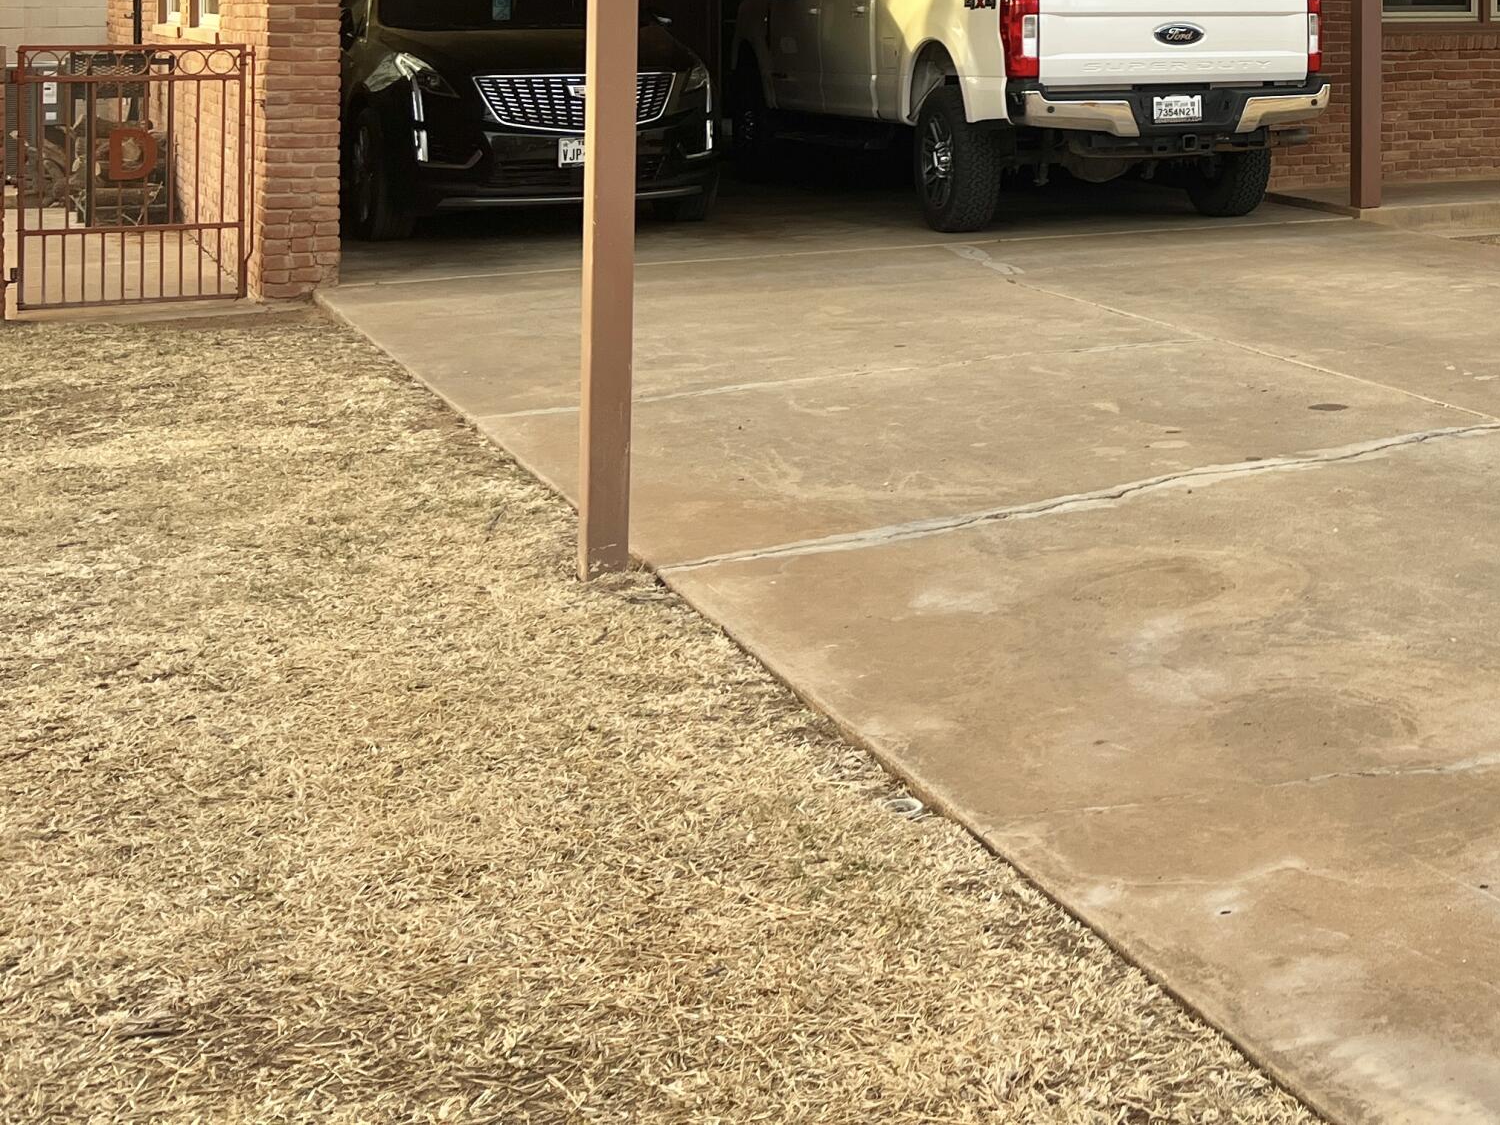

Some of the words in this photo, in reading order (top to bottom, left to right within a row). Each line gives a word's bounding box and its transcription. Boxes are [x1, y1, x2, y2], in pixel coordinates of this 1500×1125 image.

[1166, 27, 1194, 41] Ford
[1083, 60, 1189, 73] SUPER
[1195, 59, 1272, 71] DUTY
[1158, 107, 1196, 117] 7354N21
[109, 128, 157, 180] D
